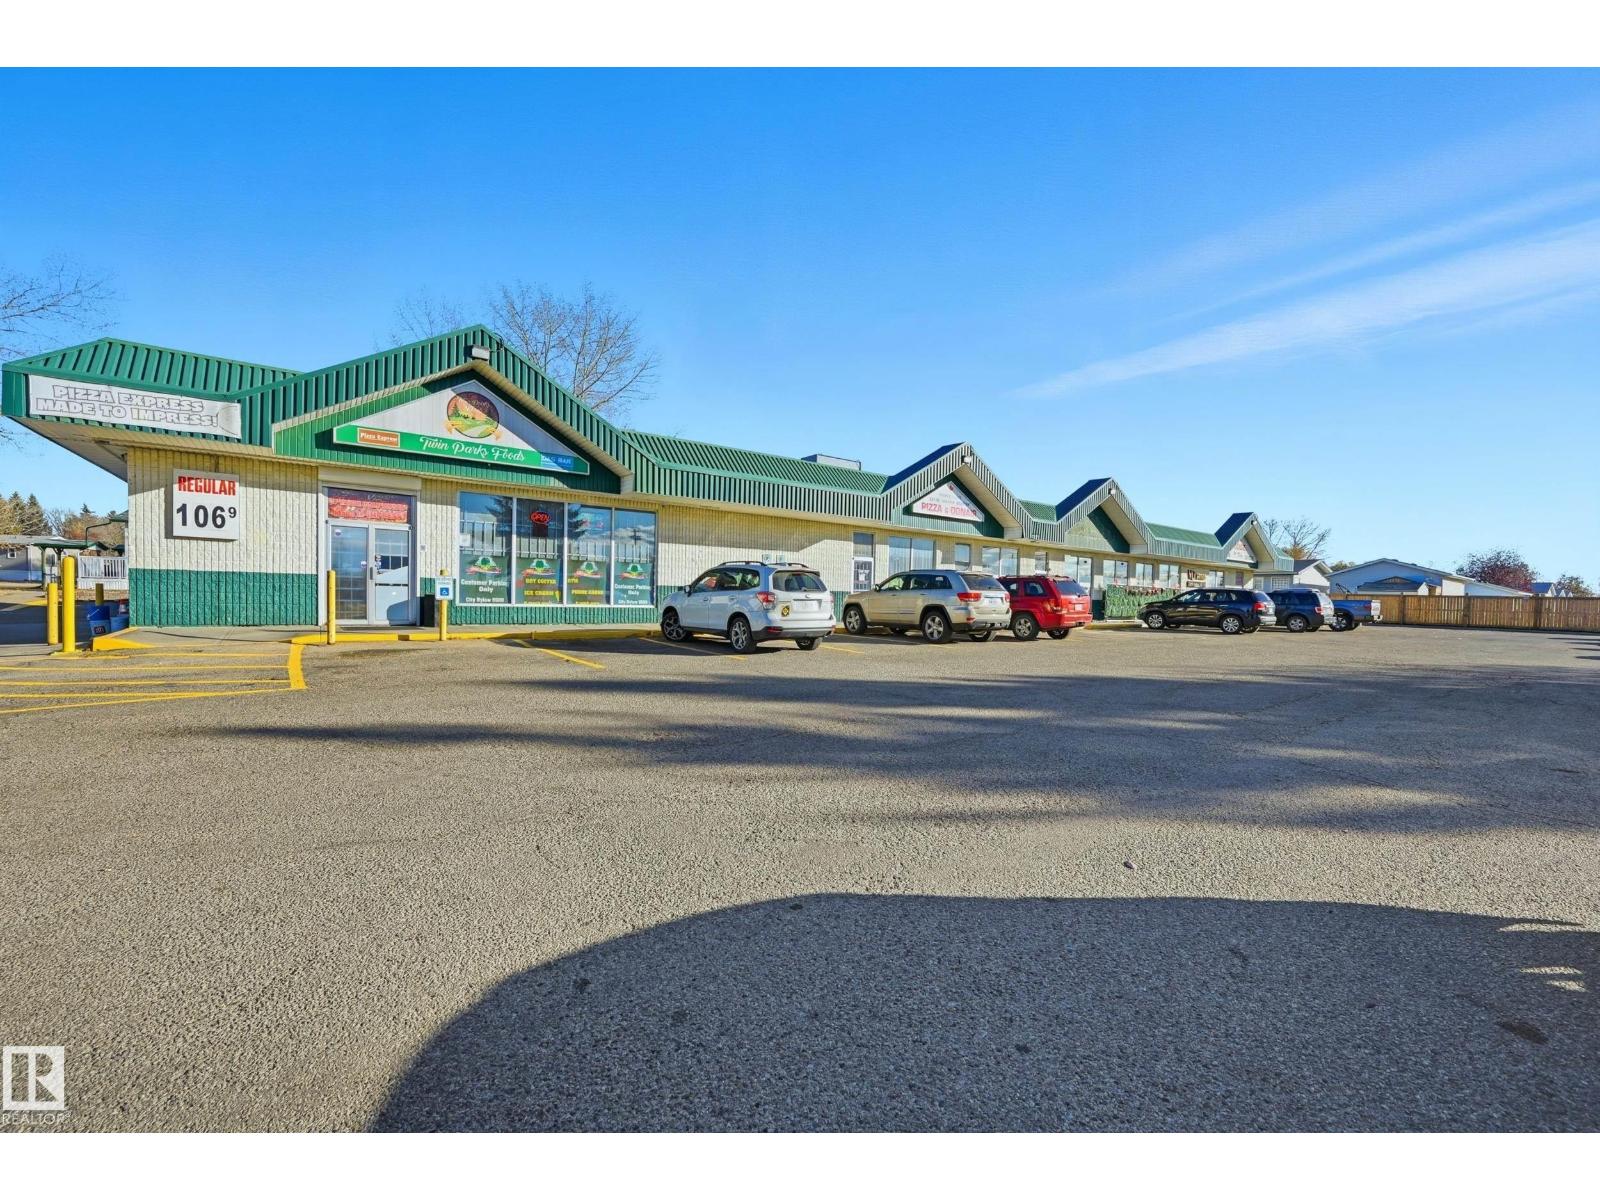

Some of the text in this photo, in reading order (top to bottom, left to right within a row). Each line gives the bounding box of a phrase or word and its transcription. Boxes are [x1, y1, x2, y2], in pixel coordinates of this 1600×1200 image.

[52, 385, 204, 412] PIZZA EXPRESS
[36, 398, 219, 427] MADE TO IMPRESS!
[419, 436, 526, 461] Twin Parks Foods
[178, 476, 236, 496] REGULAR
[532, 513, 550, 522] OPEN
[921, 502, 943, 513] PIZZA
